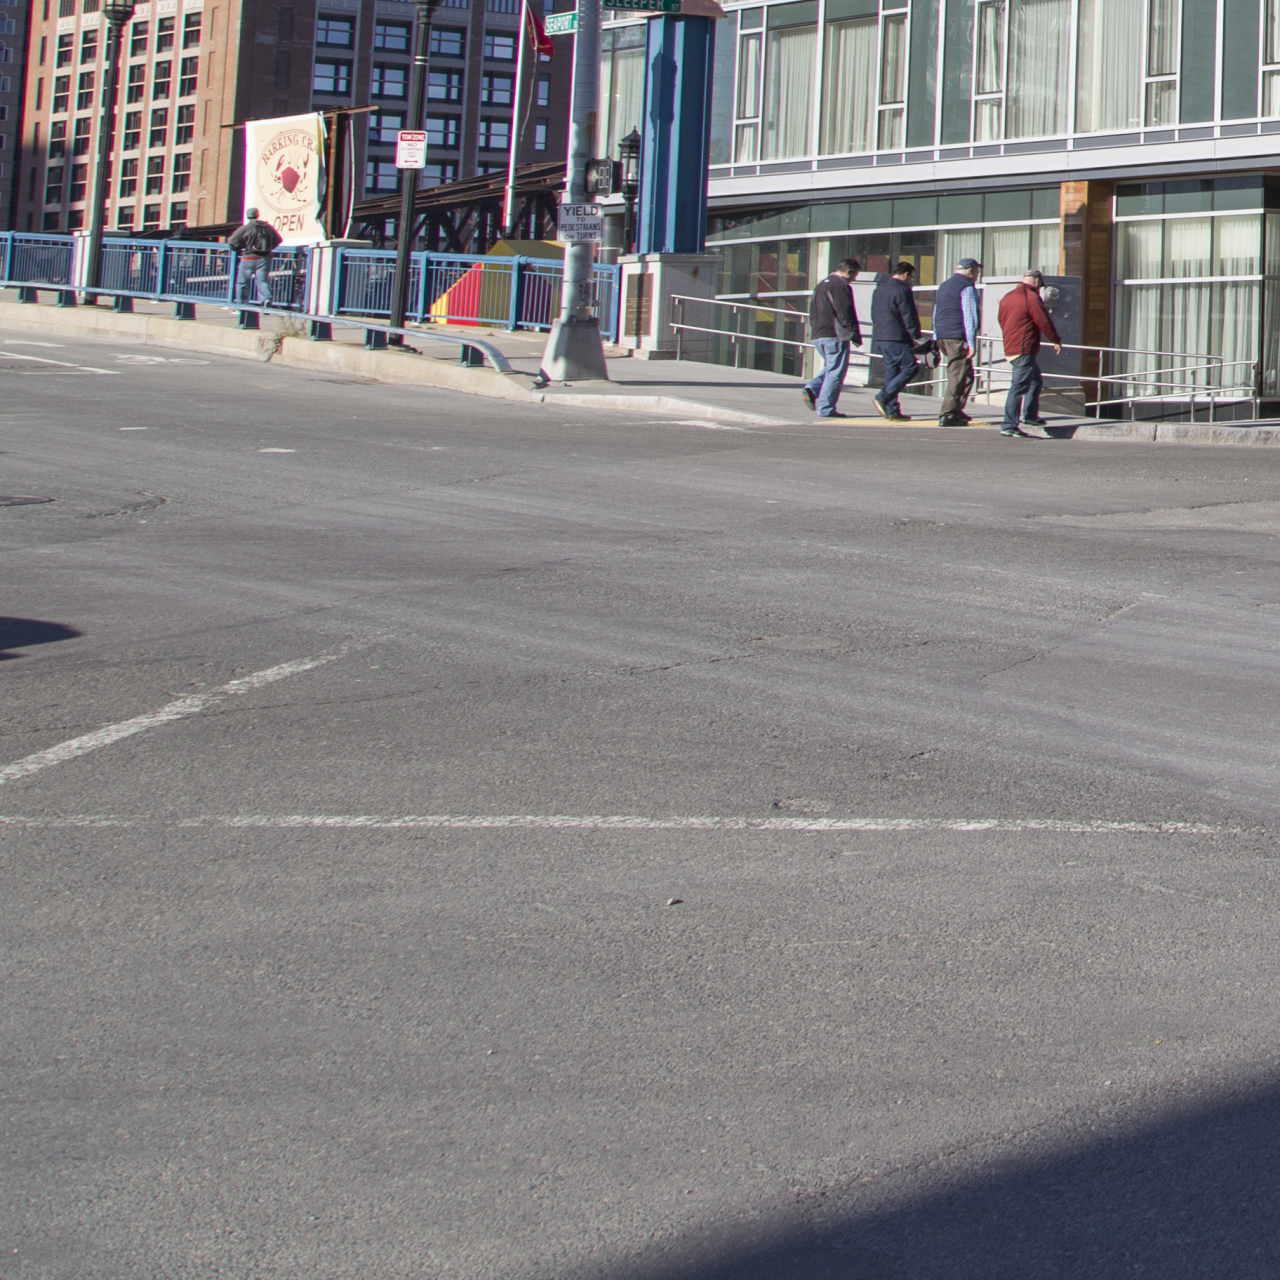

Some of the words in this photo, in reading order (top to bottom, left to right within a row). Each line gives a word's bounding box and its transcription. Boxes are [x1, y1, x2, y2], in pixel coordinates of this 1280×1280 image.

[670, 3, 680, 12] ST
[545, 14, 573, 34] SEAPORT
[262, 134, 300, 166] BARKING
[563, 205, 599, 216] YIELD
[273, 214, 305, 232] OPEN
[560, 223, 600, 232] PEDESTRIANS
